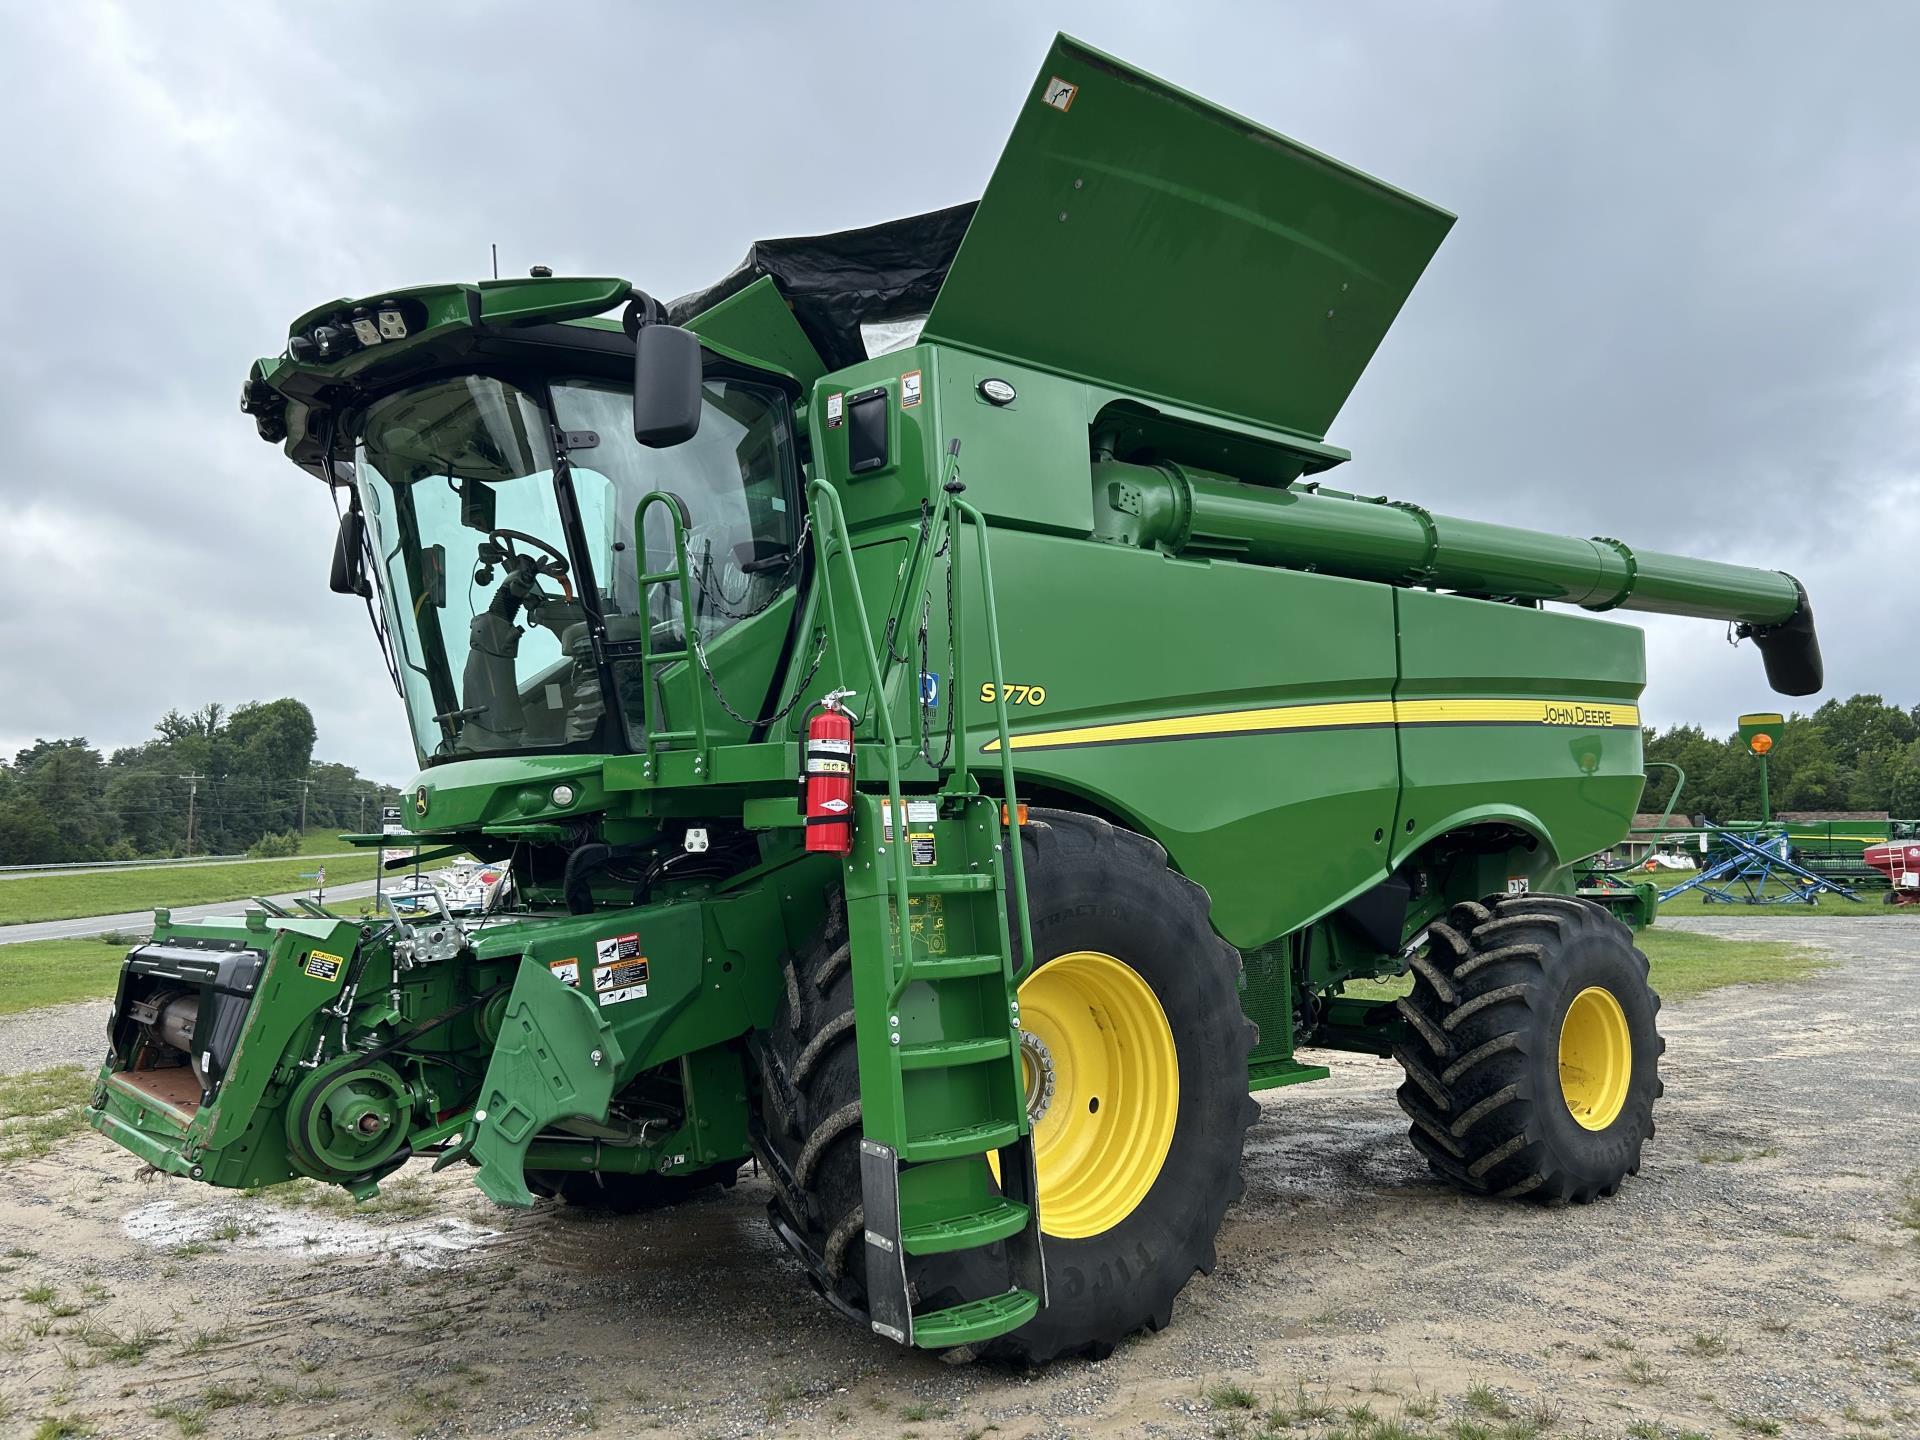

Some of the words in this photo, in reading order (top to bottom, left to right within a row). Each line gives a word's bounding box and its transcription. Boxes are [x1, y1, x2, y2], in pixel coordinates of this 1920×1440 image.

[980, 682, 1047, 707] S770
[1542, 704, 1574, 723] JOHN
[1575, 706, 1612, 724] DEERE
[317, 952, 342, 963] CAUTION
